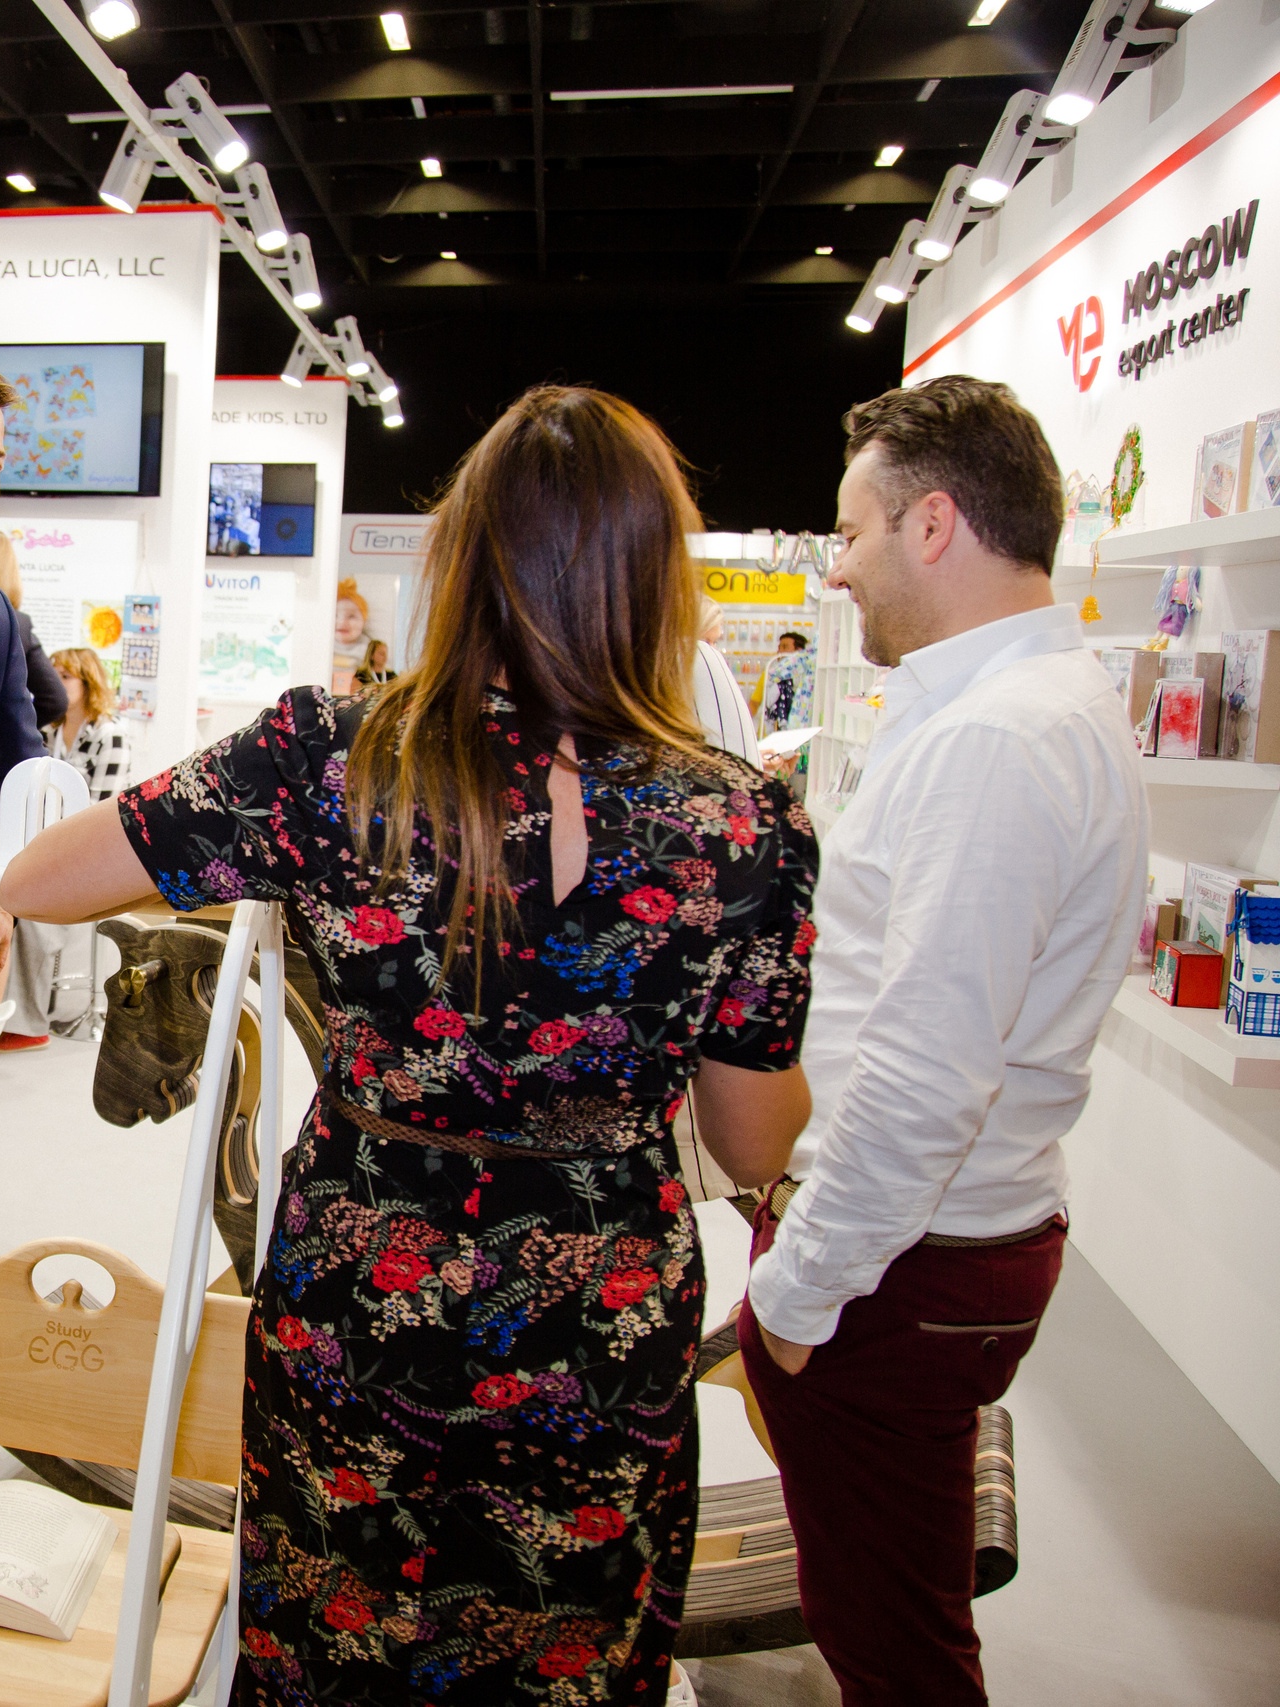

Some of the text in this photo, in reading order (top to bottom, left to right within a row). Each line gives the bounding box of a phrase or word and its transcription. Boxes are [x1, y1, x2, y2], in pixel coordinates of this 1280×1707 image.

[28, 258, 110, 279] LUCIA,
[118, 256, 165, 277] LLC
[1122, 199, 1260, 324] MOSCOW
[1118, 288, 1250, 381] export center
[46, 1320, 91, 1342] Study
[28, 1335, 104, 1372] EGG
